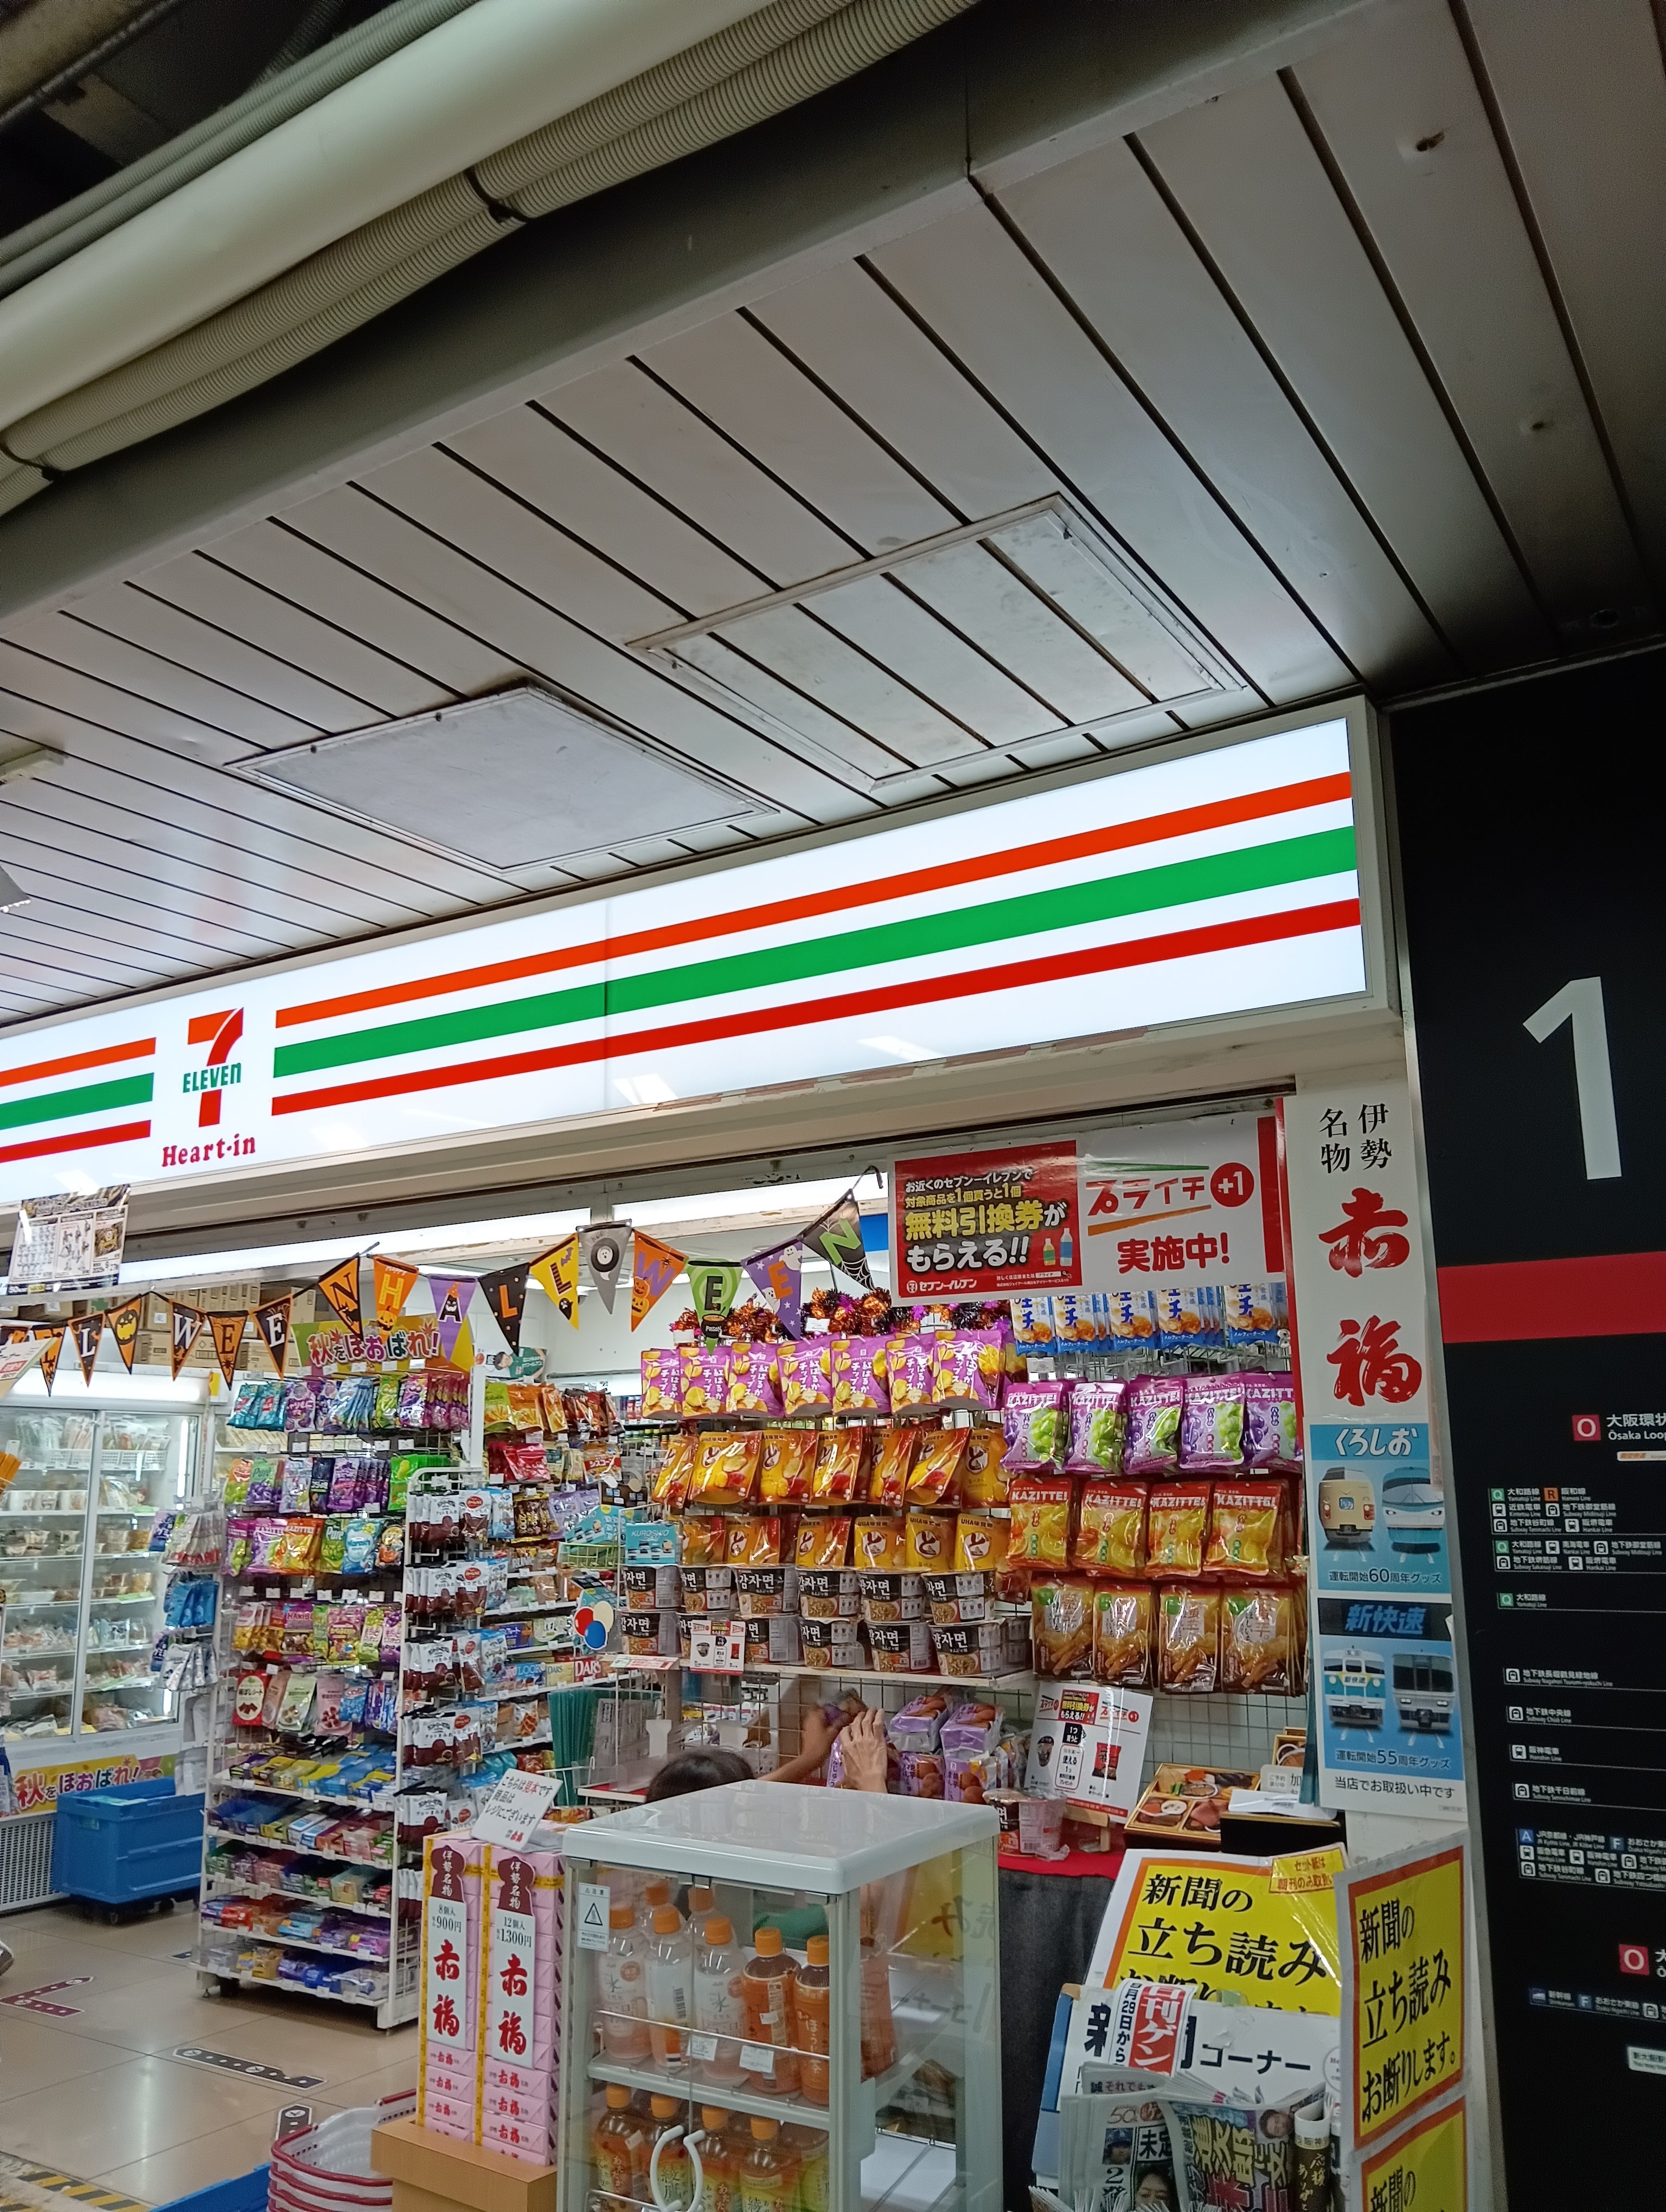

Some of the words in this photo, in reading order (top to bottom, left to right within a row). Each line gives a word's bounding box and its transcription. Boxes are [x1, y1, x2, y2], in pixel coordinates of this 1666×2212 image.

[1523, 976, 1622, 1179] 1
[1086, 1176, 1204, 1217] プライチ
[905, 1200, 1068, 1241] 無料引換券が
[739, 1573, 774, 1591] 감자면
[1329, 1568, 1442, 1584] 運転開始60周年グッズ
[1345, 1604, 1427, 1635] 新快速
[1336, 1749, 1451, 1770] 運転開始55周年グッズ
[1335, 1776, 1454, 1799] 当店でお取扱い中です
[1142, 1874, 1253, 1912] 新聞の
[437, 1915, 462, 1933] 900円
[1360, 1896, 1415, 1964] 新聞の
[1128, 1917, 1328, 1986] 立ち読み
[1362, 1949, 1452, 2049] 立ち読み
[1361, 2031, 1456, 2122] お断りします。
